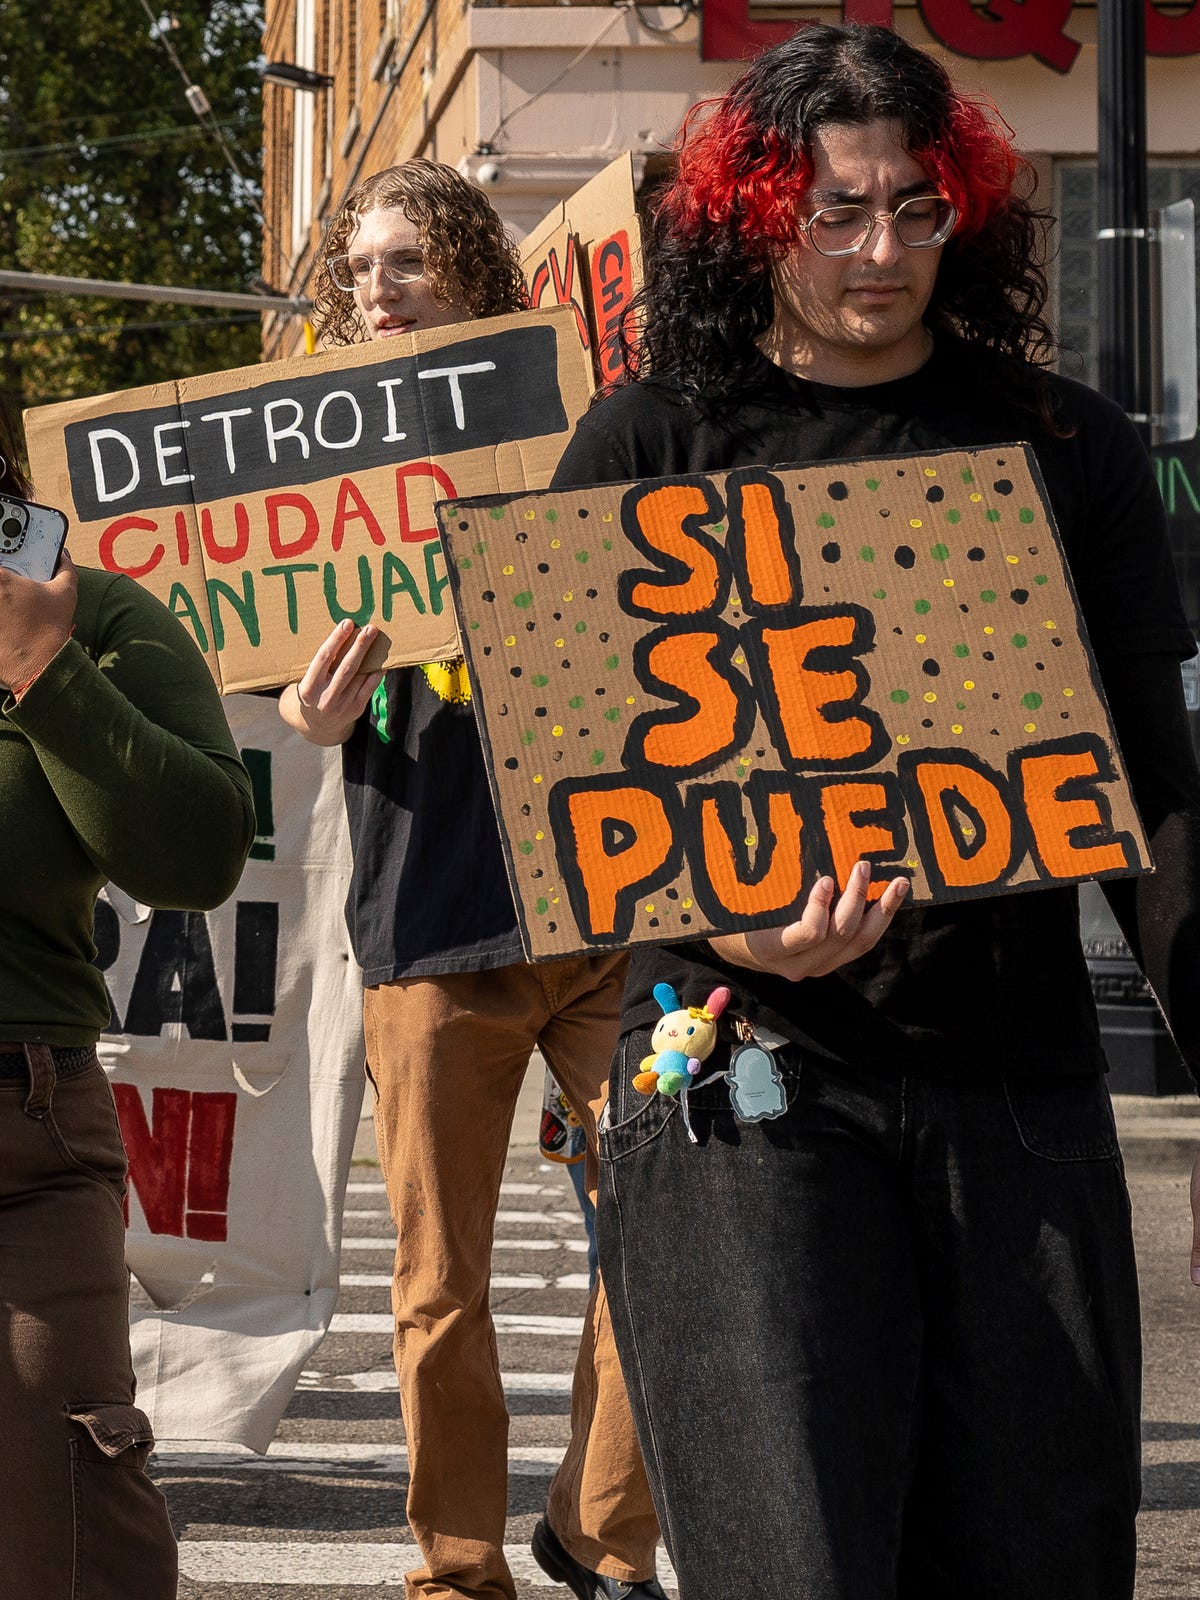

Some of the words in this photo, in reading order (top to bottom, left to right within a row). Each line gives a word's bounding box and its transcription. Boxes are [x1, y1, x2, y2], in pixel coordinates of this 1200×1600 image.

[88, 361, 497, 503] DETROIT
[99, 462, 458, 579] CIUDAD
[617, 469, 804, 623] SI
[622, 602, 893, 778] SE
[549, 731, 1153, 944] PUEDE
